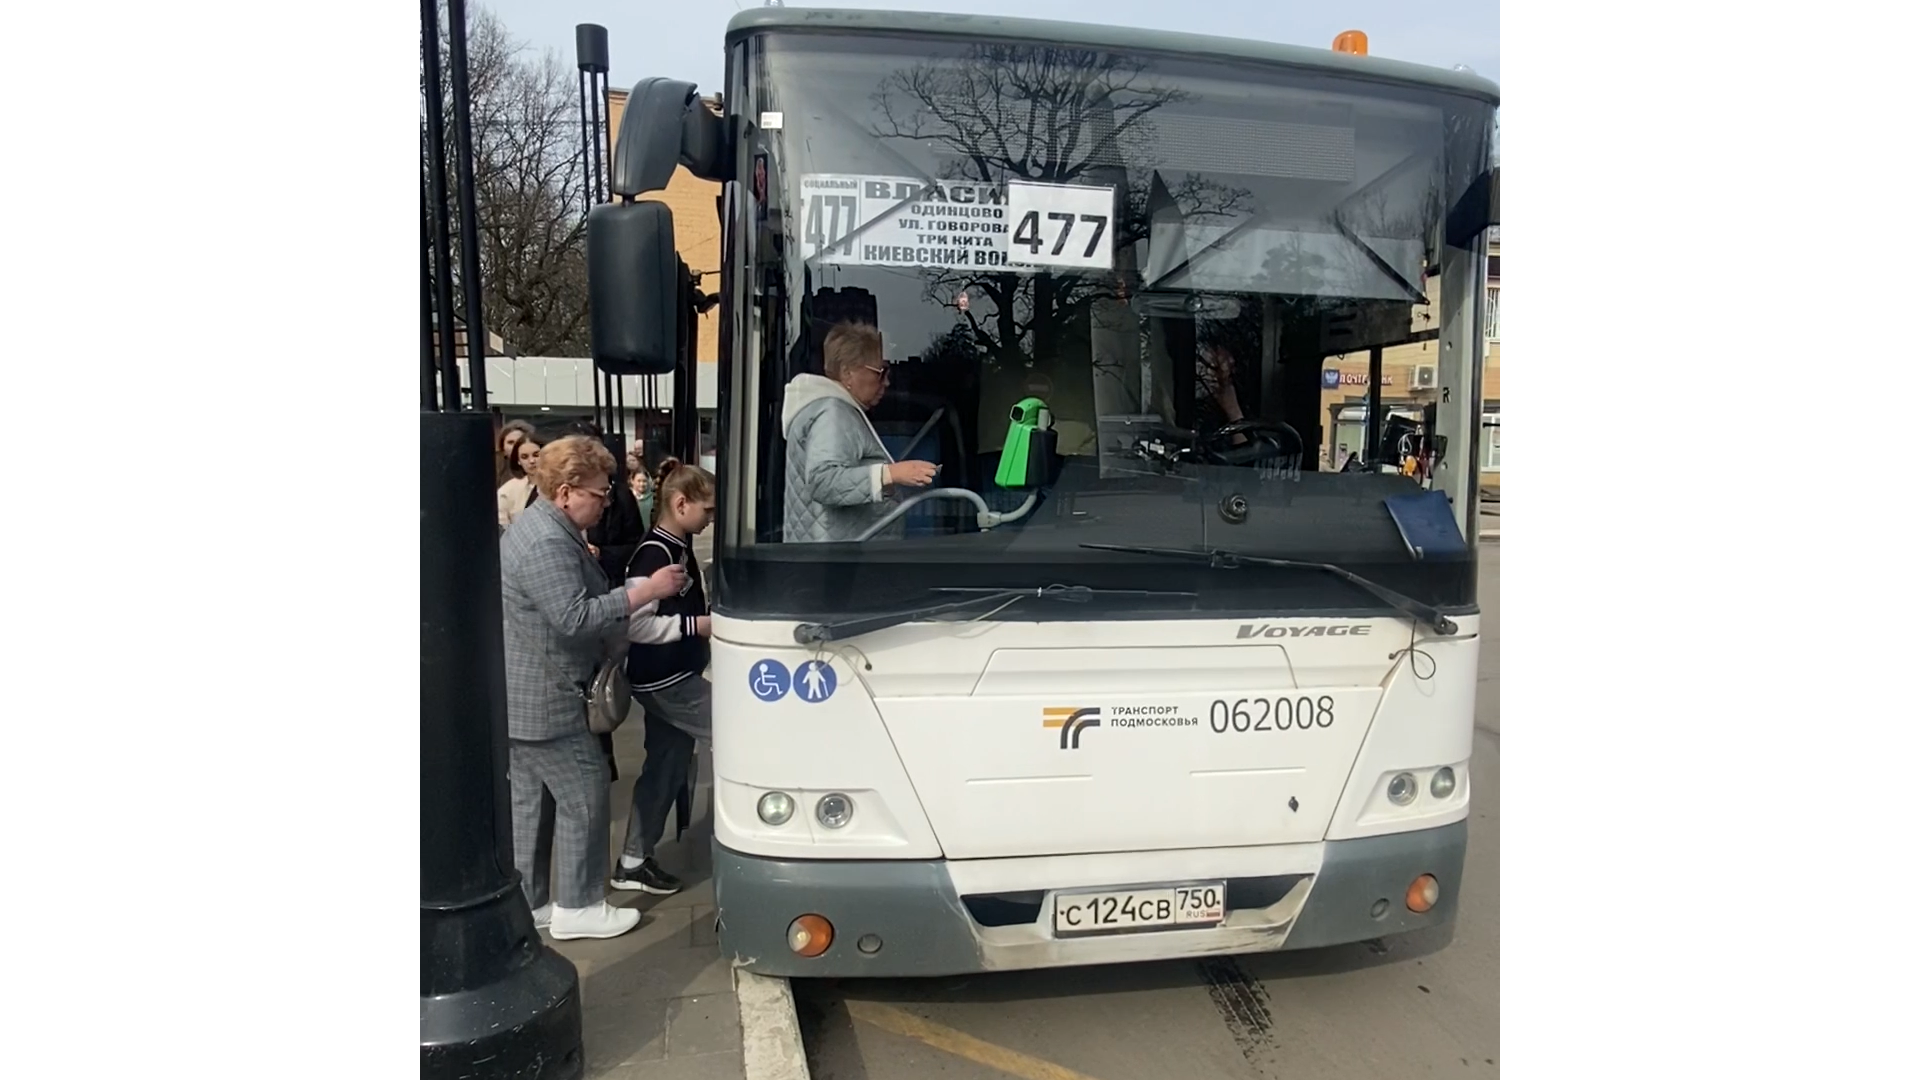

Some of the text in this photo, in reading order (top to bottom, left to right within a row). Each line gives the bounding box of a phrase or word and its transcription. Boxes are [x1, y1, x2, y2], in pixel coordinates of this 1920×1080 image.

[804, 180, 858, 189] СОЦИАЛЬНЫЙ
[864, 181, 1008, 206] ВЛАСИ
[911, 204, 1003, 219] ОДИНЦОВО
[805, 195, 857, 256] 477
[898, 219, 925, 230] УЛ.
[916, 234, 994, 247] ТРИ КИТА
[1013, 210, 1108, 258] 477
[864, 245, 969, 265] КИЕВСКИЙ
[1236, 625, 1372, 639] VOYAGE
[1111, 696, 1334, 733] ТРАНСПОРТ 062008
[1111, 718, 1198, 728] ПОДМОСКОВЬЯ
[1177, 888, 1216, 910] 750
